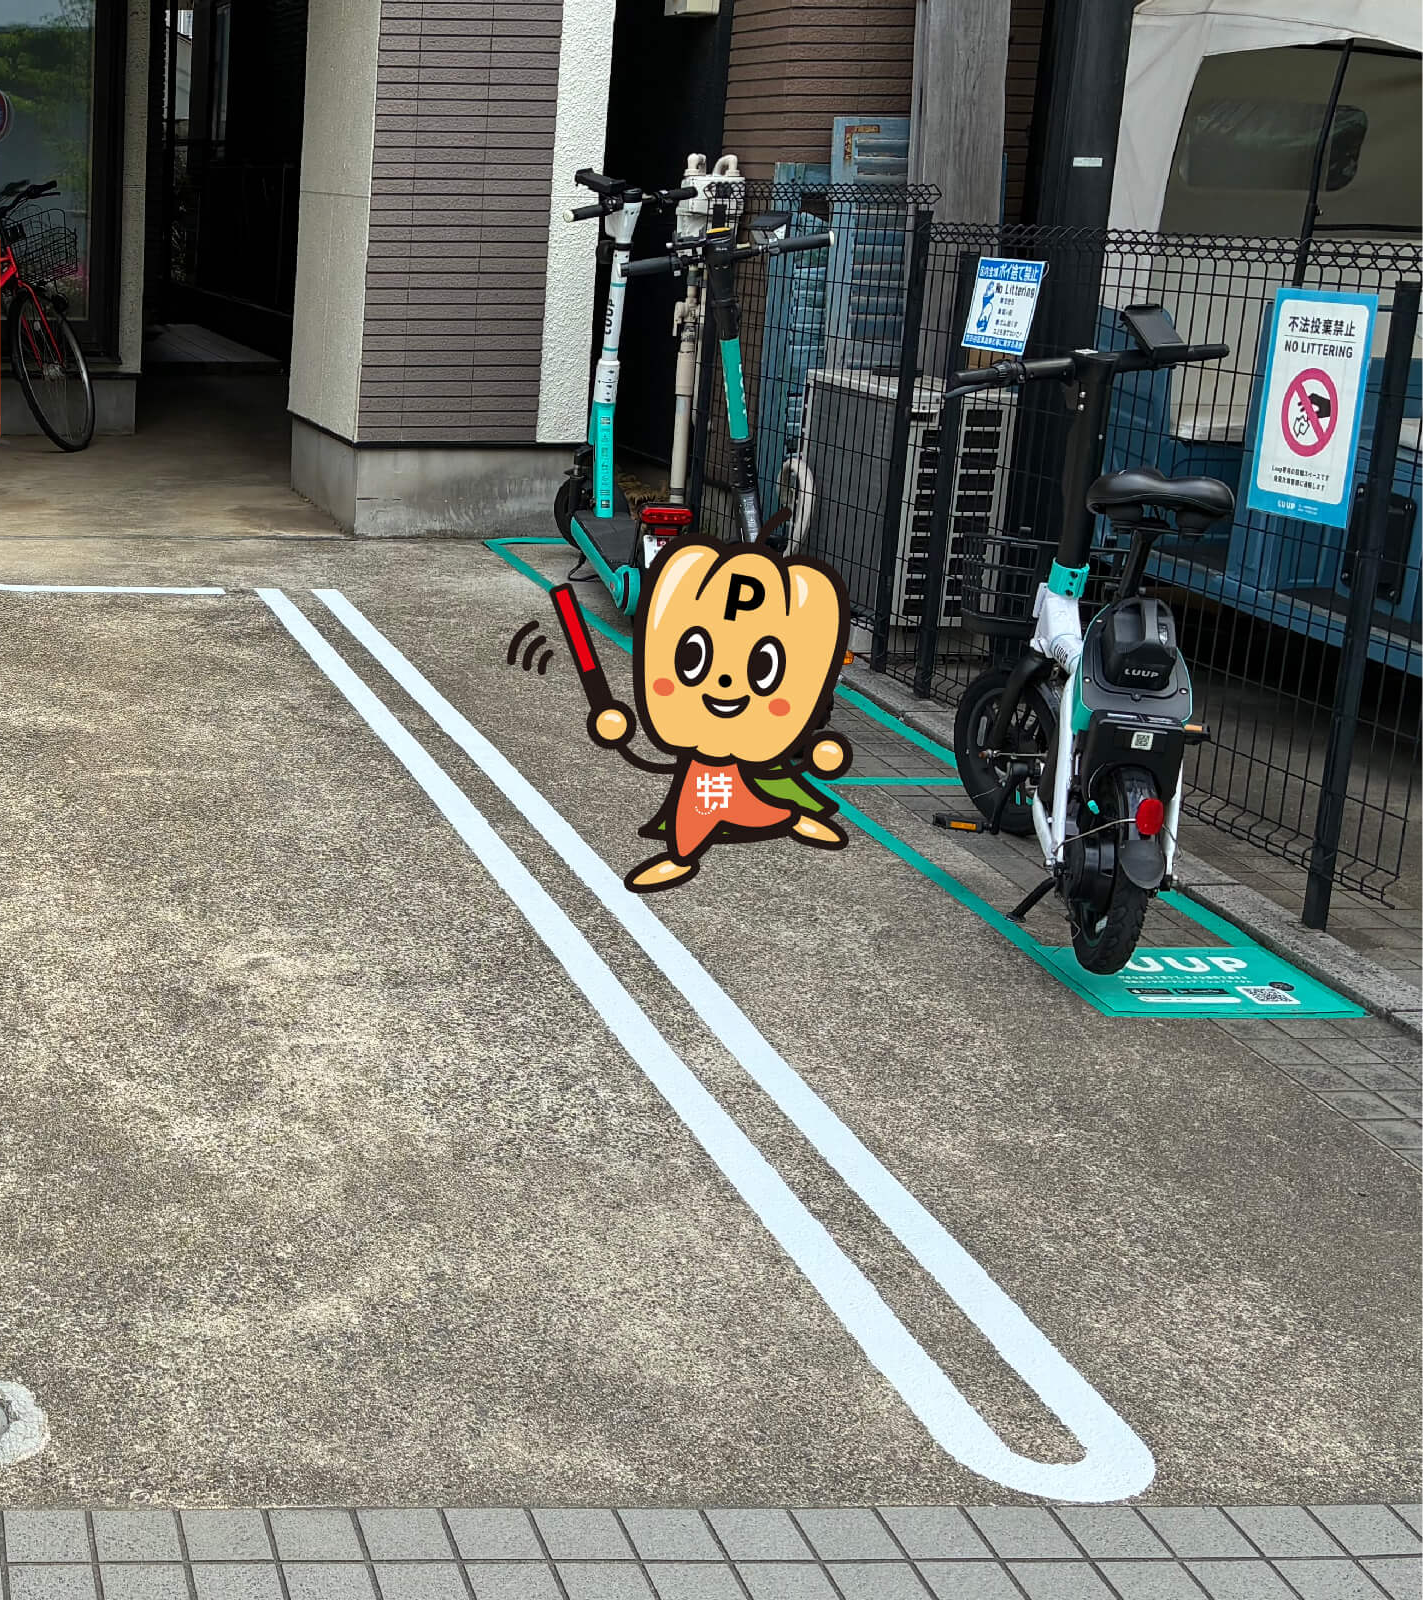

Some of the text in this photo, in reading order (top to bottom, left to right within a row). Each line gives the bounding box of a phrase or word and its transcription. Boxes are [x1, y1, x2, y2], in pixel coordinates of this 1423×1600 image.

[1005, 283, 1035, 299] Littering
[1288, 316, 1356, 337] 不法投棄禁止
[1284, 340, 1353, 359] NO LITTERING
[1124, 668, 1160, 678] LUUP
[1124, 956, 1248, 972] UUP
